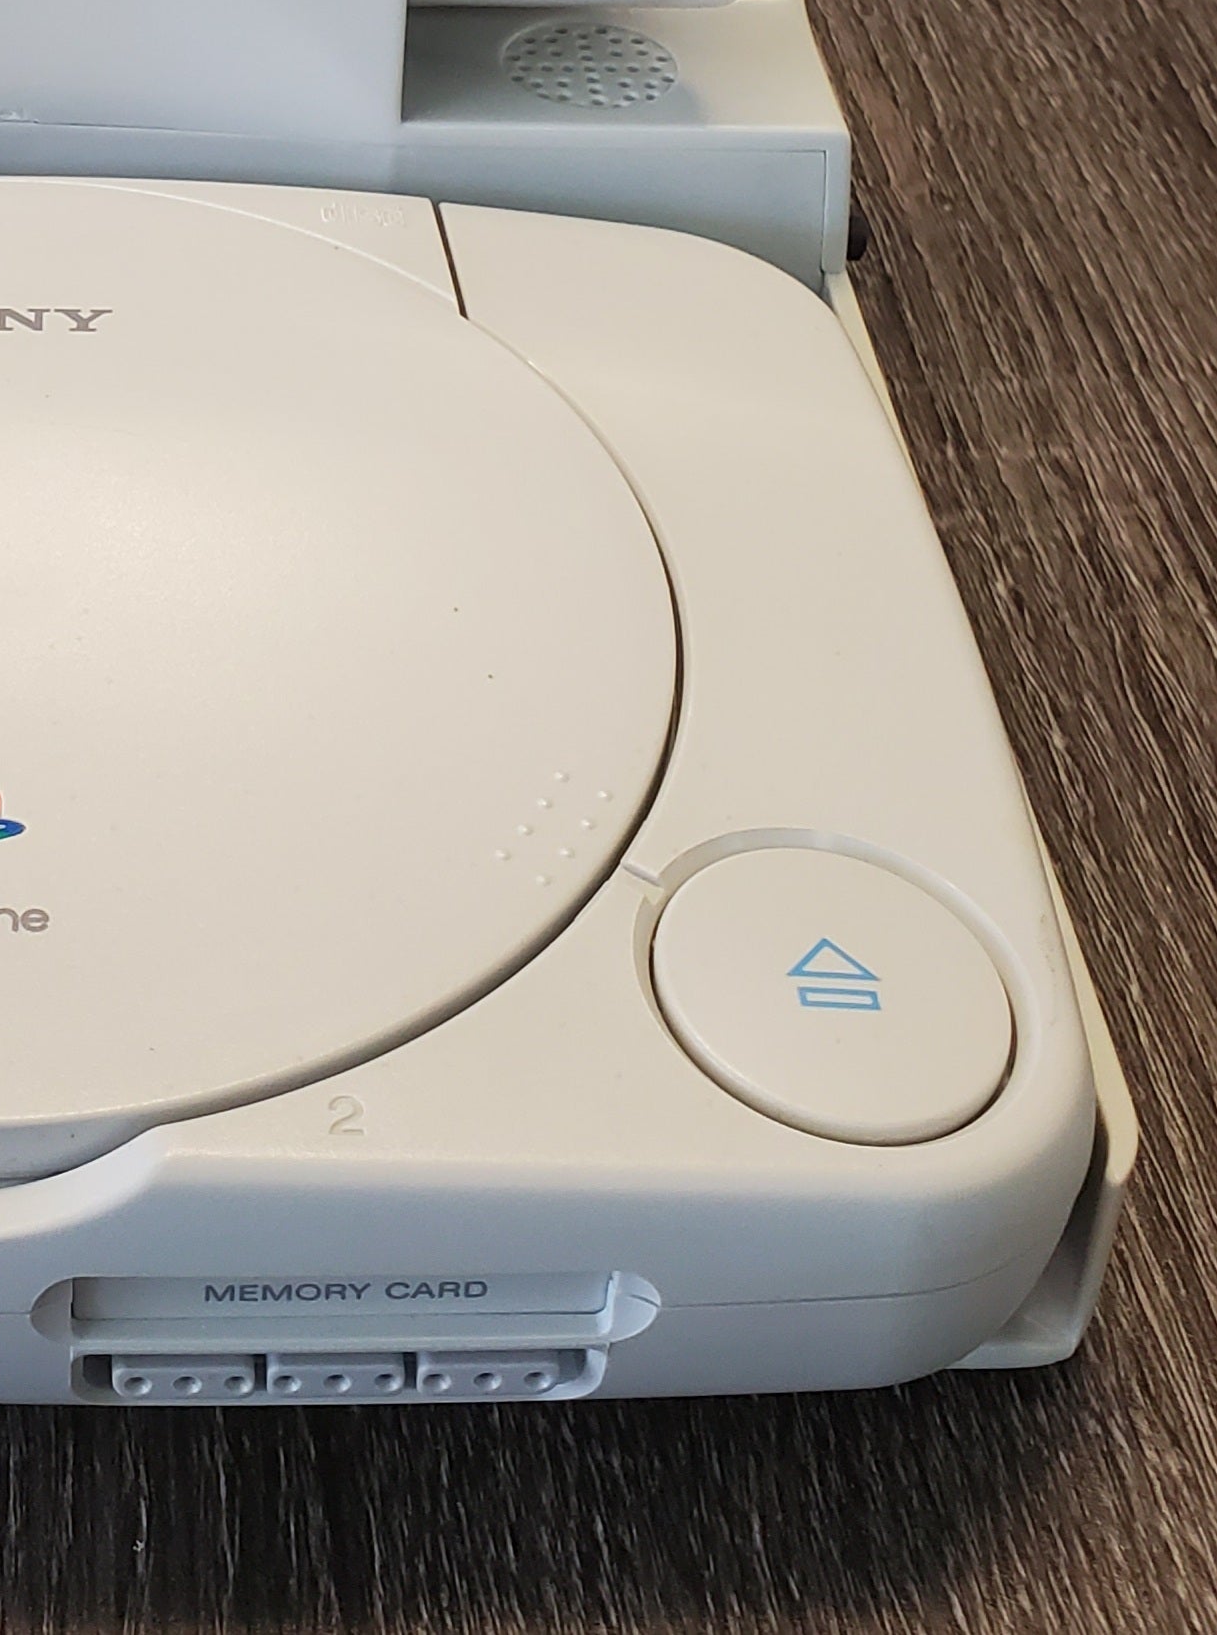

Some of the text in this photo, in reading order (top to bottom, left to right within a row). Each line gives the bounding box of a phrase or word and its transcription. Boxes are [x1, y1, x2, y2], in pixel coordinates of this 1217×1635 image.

[327, 1094, 365, 1137] 2
[203, 1280, 489, 1303] MEMORY CARD
